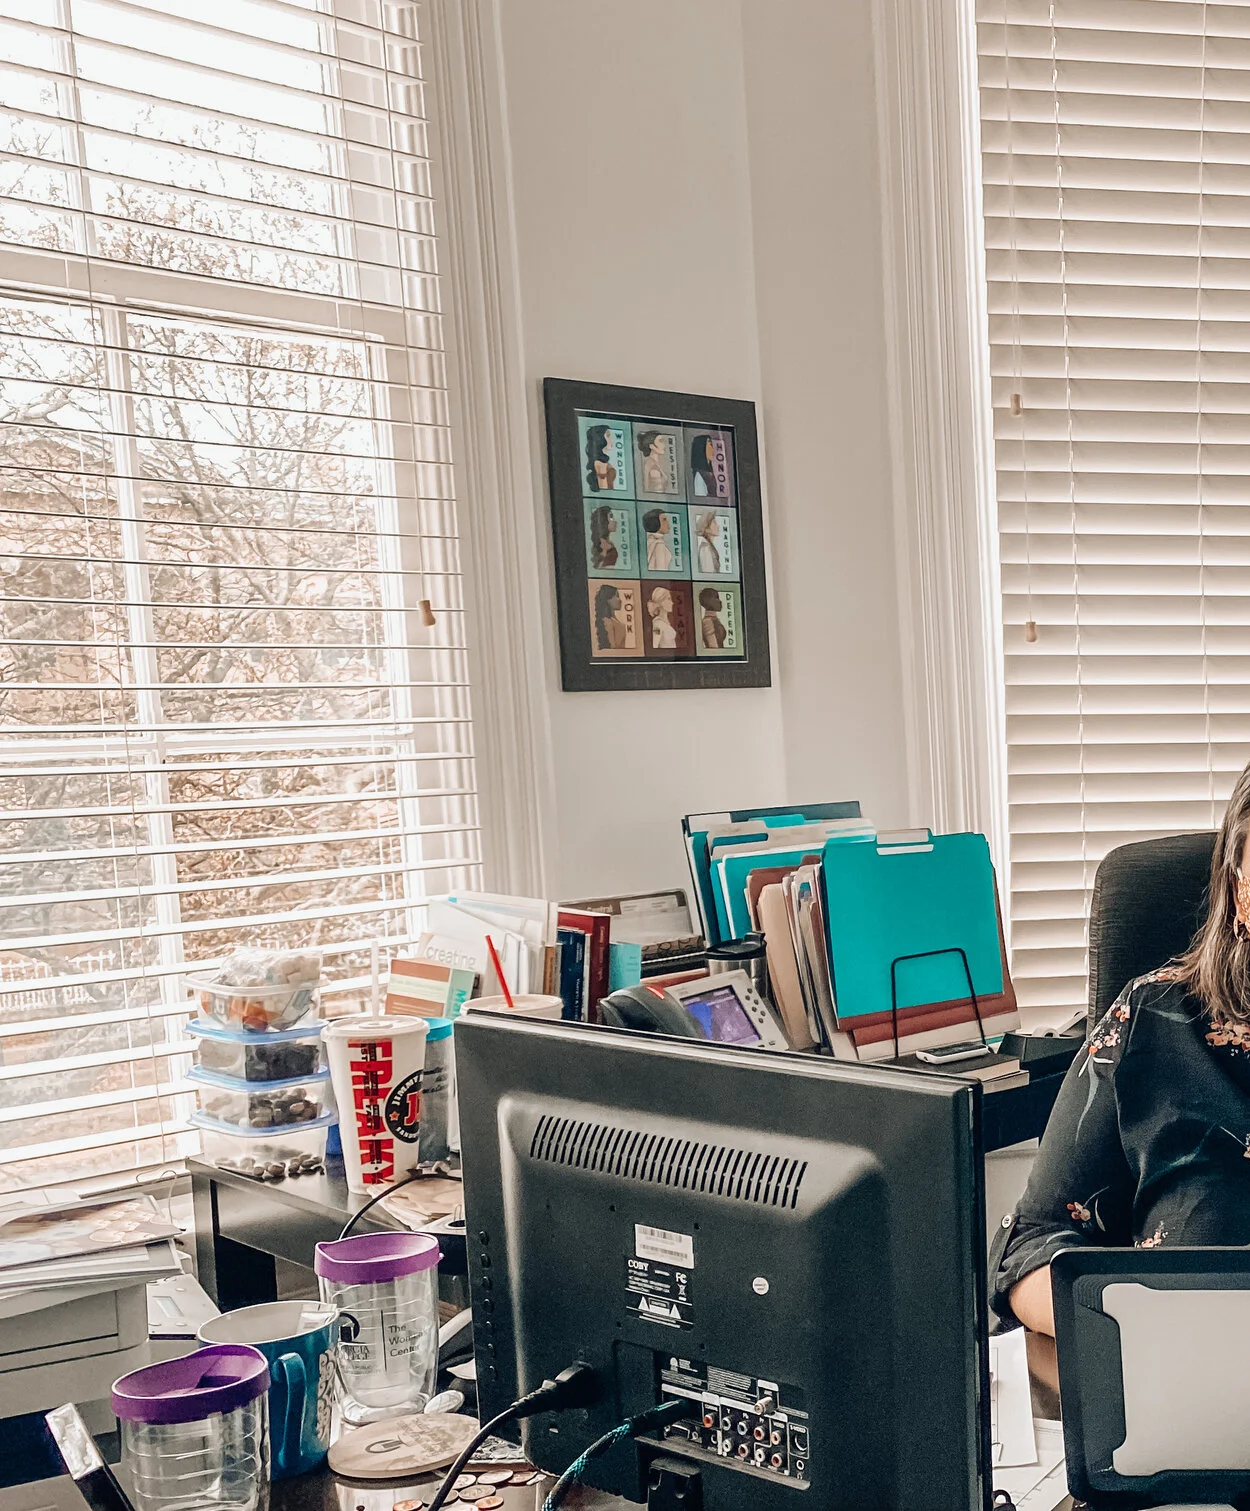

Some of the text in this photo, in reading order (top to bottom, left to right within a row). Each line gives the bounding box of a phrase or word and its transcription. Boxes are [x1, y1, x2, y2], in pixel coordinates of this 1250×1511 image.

[615, 432, 624, 485] WONDER
[668, 437, 676, 490] RESIST
[716, 443, 726, 493] HONOR
[672, 516, 680, 567] REBEL
[722, 519, 731, 572] IMAGINE
[624, 592, 634, 633] WORK
[725, 592, 735, 646] DEFEND
[426, 945, 477, 970] creating
[347, 1038, 394, 1185] FREAKY
[388, 1324, 407, 1333] The
